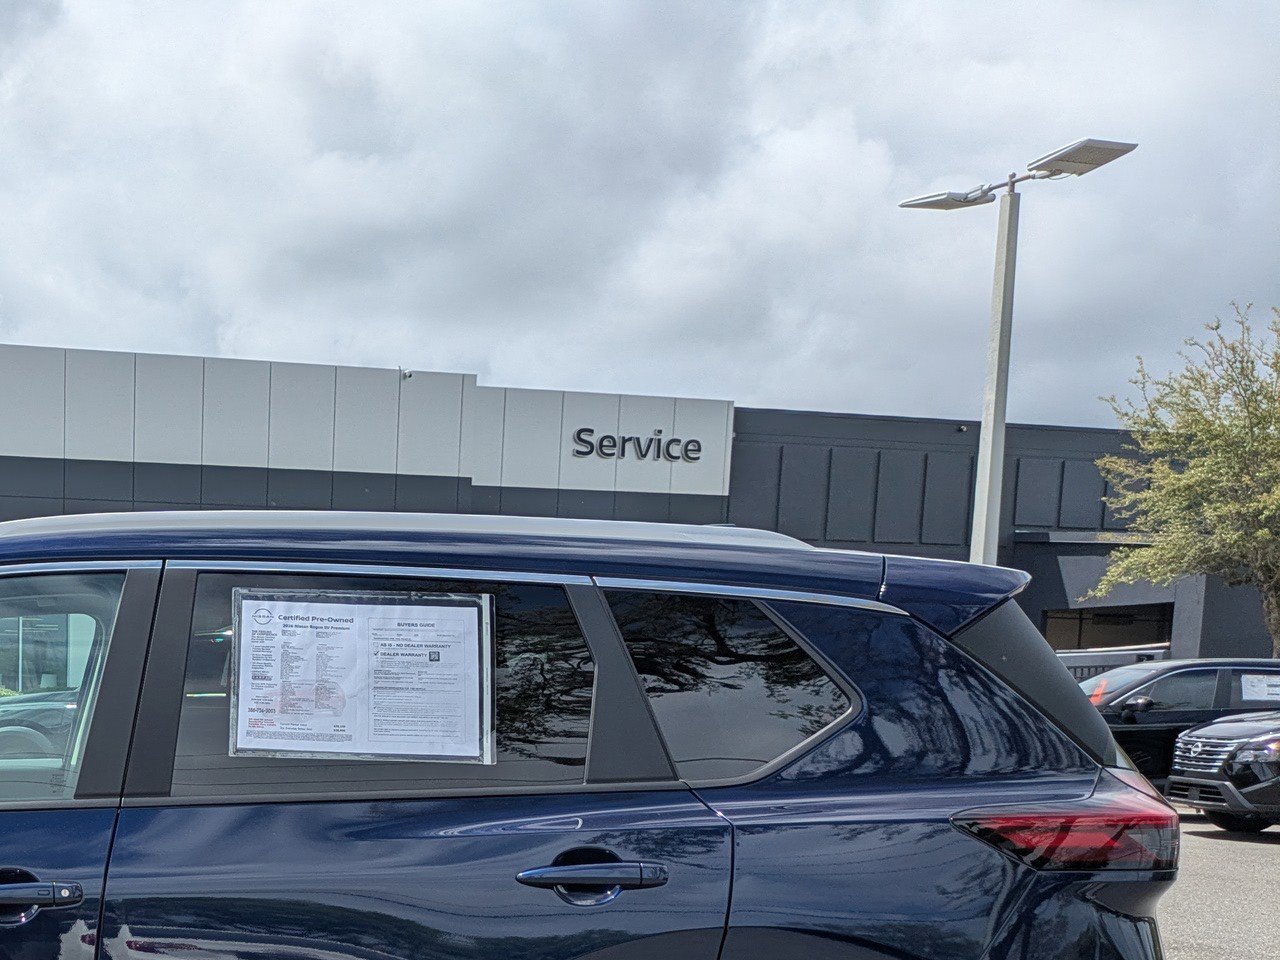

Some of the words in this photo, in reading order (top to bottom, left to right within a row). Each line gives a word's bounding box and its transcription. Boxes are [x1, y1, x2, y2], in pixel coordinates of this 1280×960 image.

[572, 427, 703, 463] Service
[277, 614, 310, 622] Certified
[311, 616, 354, 624] Pre-Owned
